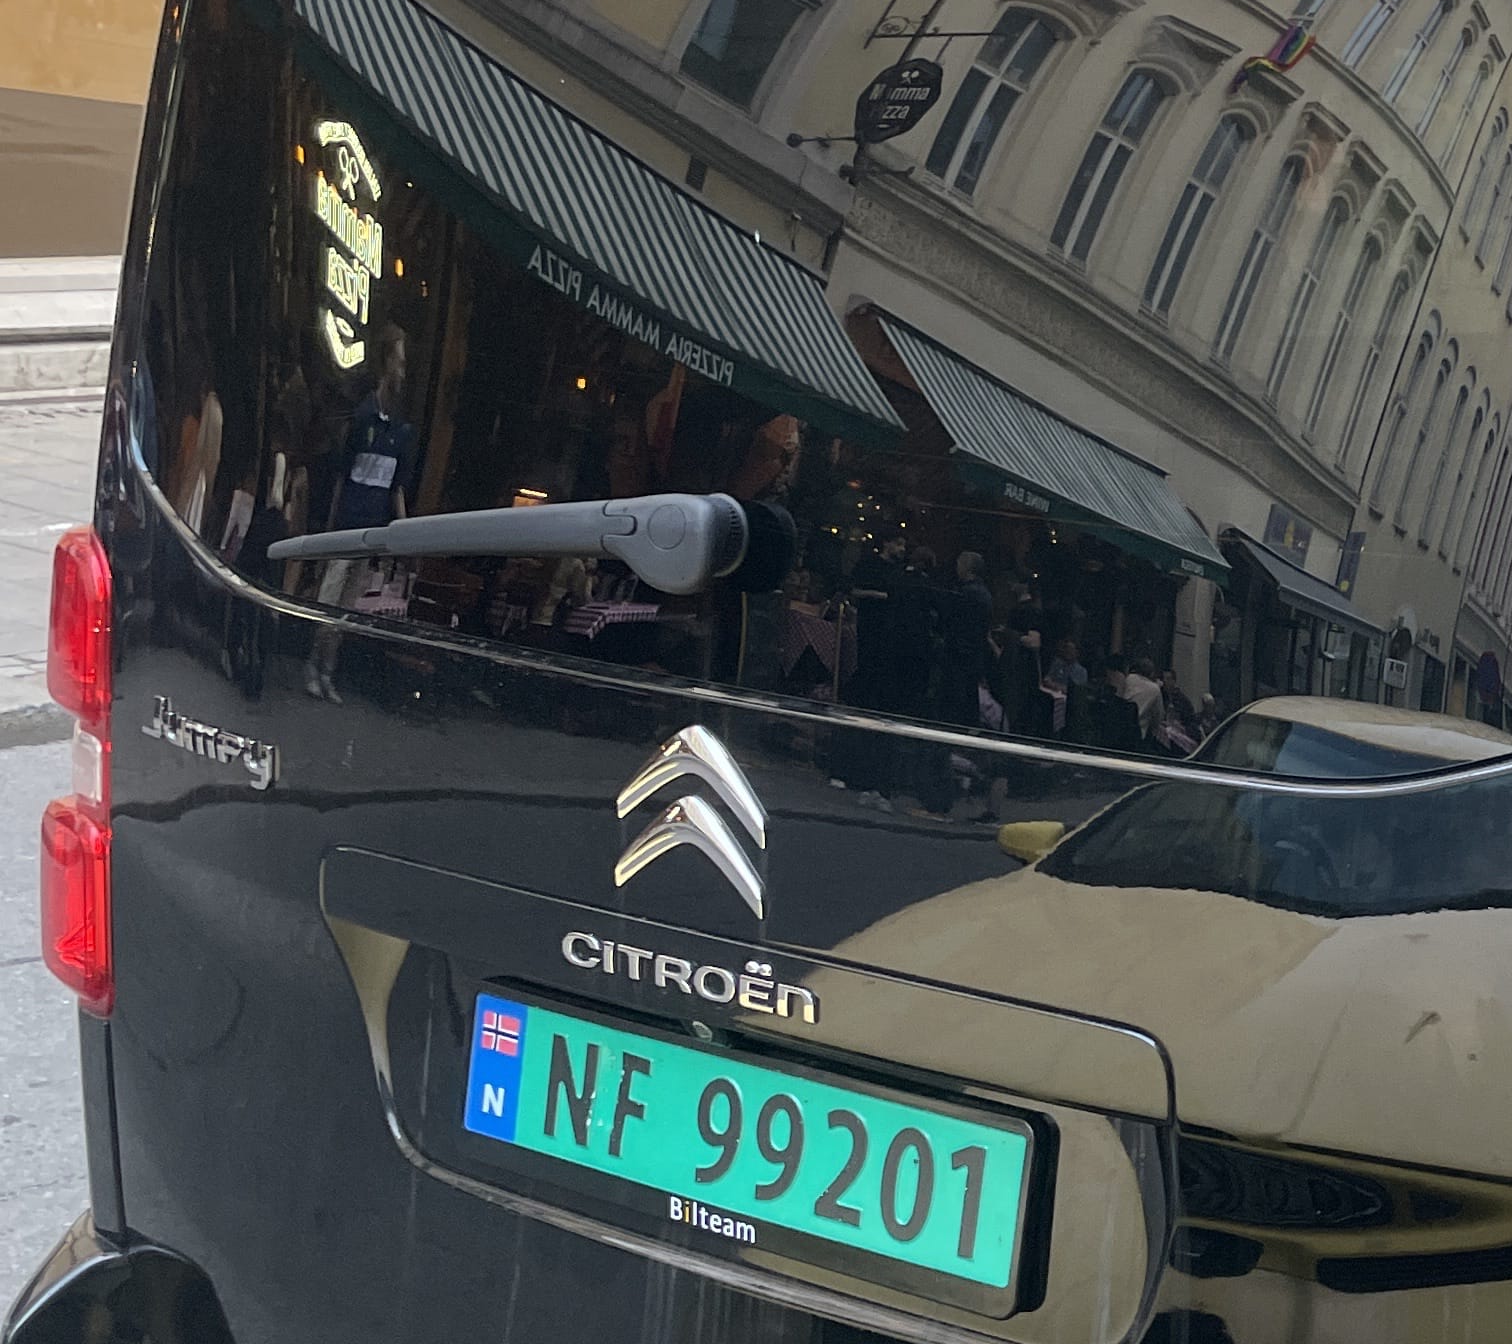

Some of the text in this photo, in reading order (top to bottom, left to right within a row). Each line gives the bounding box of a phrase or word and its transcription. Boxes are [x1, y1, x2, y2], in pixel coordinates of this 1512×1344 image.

[142, 695, 281, 791] Jumpy
[481, 1083, 505, 1118] N
[543, 1033, 989, 1259] NF 99201
[669, 1196, 757, 1245] Bilteam
